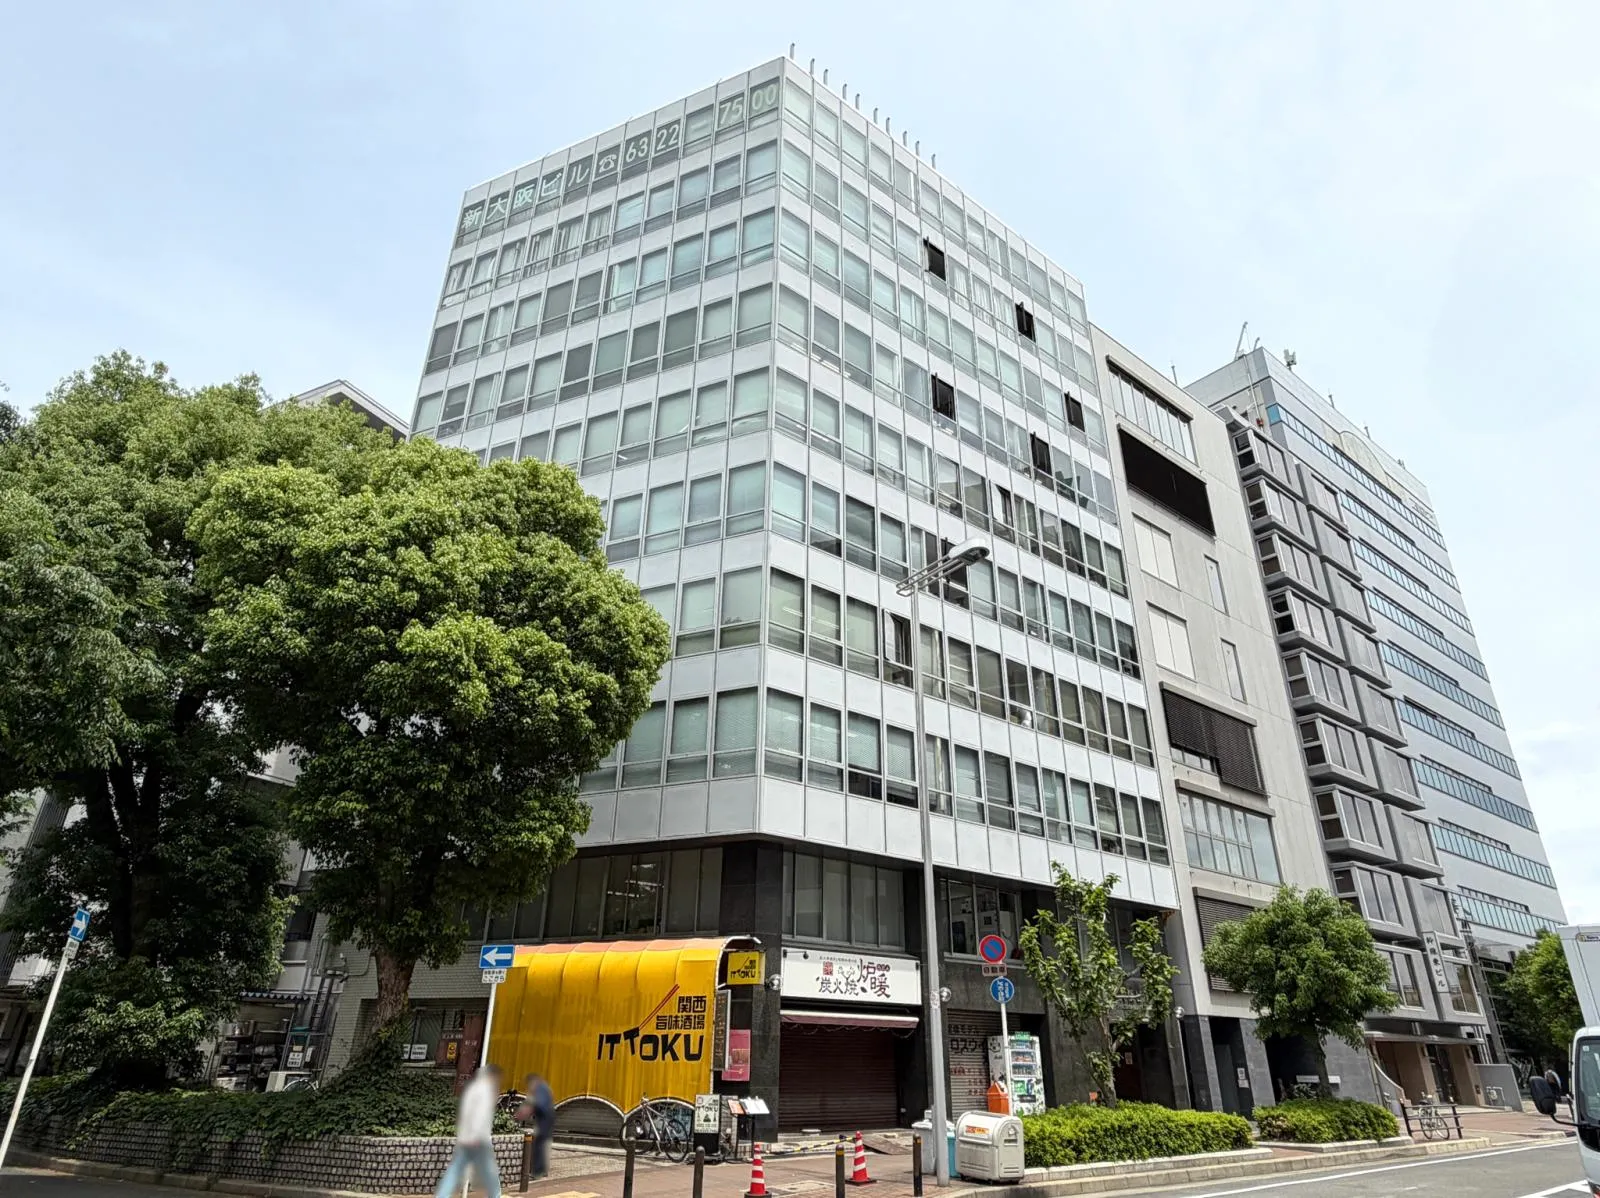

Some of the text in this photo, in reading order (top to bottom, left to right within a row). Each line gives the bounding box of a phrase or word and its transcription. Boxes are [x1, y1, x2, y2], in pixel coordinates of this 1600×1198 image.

[462, 164, 590, 229] 新大阪ビル
[730, 969, 756, 979] ITTOKU
[677, 995, 707, 1013] 関西
[655, 1014, 705, 1030] 旨味酒場
[597, 1026, 704, 1062] ITTOKU
